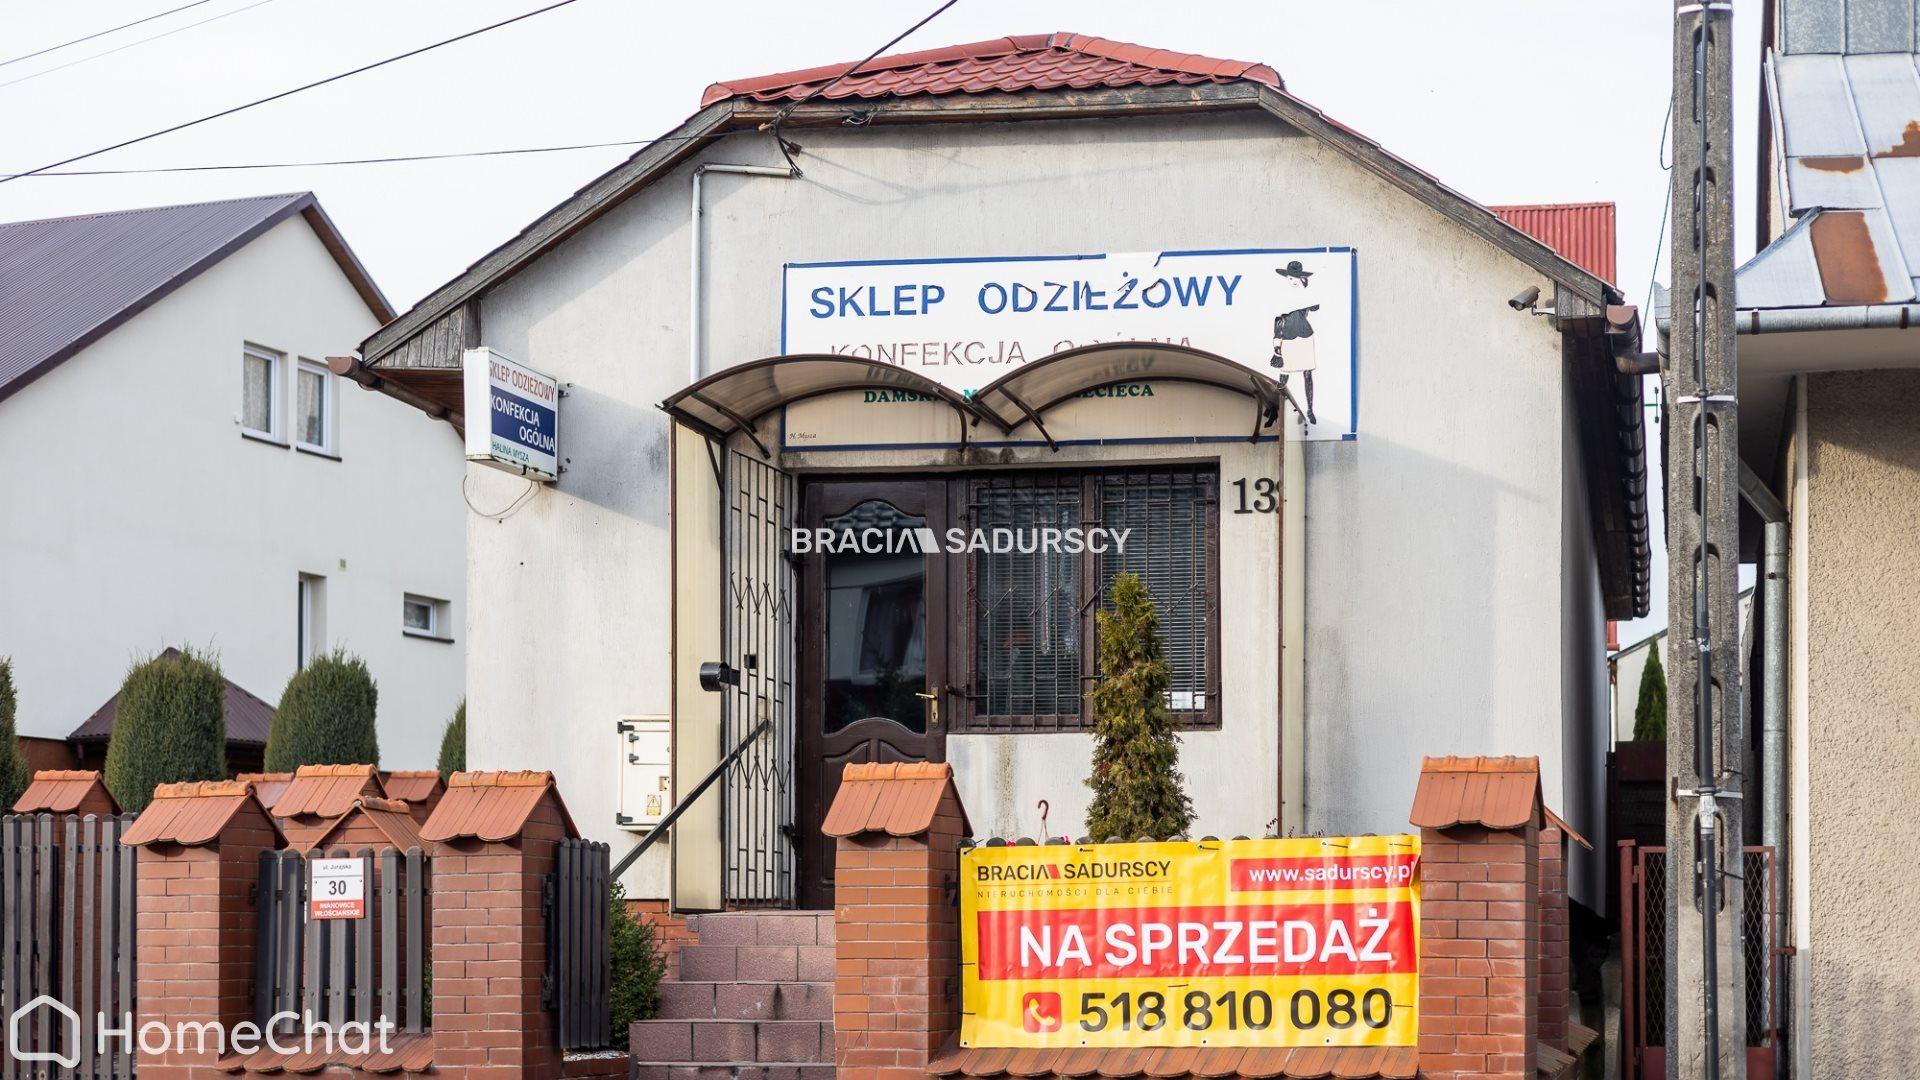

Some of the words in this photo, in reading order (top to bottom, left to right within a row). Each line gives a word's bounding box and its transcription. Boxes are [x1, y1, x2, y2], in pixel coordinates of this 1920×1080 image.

[810, 284, 946, 319] SKLEP
[978, 270, 1243, 315] ODZIEŻOWY
[489, 360, 511, 384] SKLEP
[511, 370, 555, 403] ODZIEŻOWY
[863, 389, 938, 403] DAMSK
[490, 393, 540, 427] KONFEKCJA
[491, 441, 513, 456] HALINA
[519, 427, 555, 452] OGÓLNA
[1233, 477, 1279, 514] 13
[1064, 860, 1171, 879] SADURSCY
[328, 880, 347, 895] 30
[977, 888, 1088, 899] NIERUCHOMOŚCI
[1096, 887, 1120, 896] DLA
[1127, 886, 1173, 895] CIEBIE
[1019, 924, 1092, 967] NA
[1104, 907, 1392, 966] SPRZEDAŻ
[1079, 992, 1167, 1032] 518
[1183, 990, 1273, 1031] 810
[1290, 988, 1393, 1030] 080
